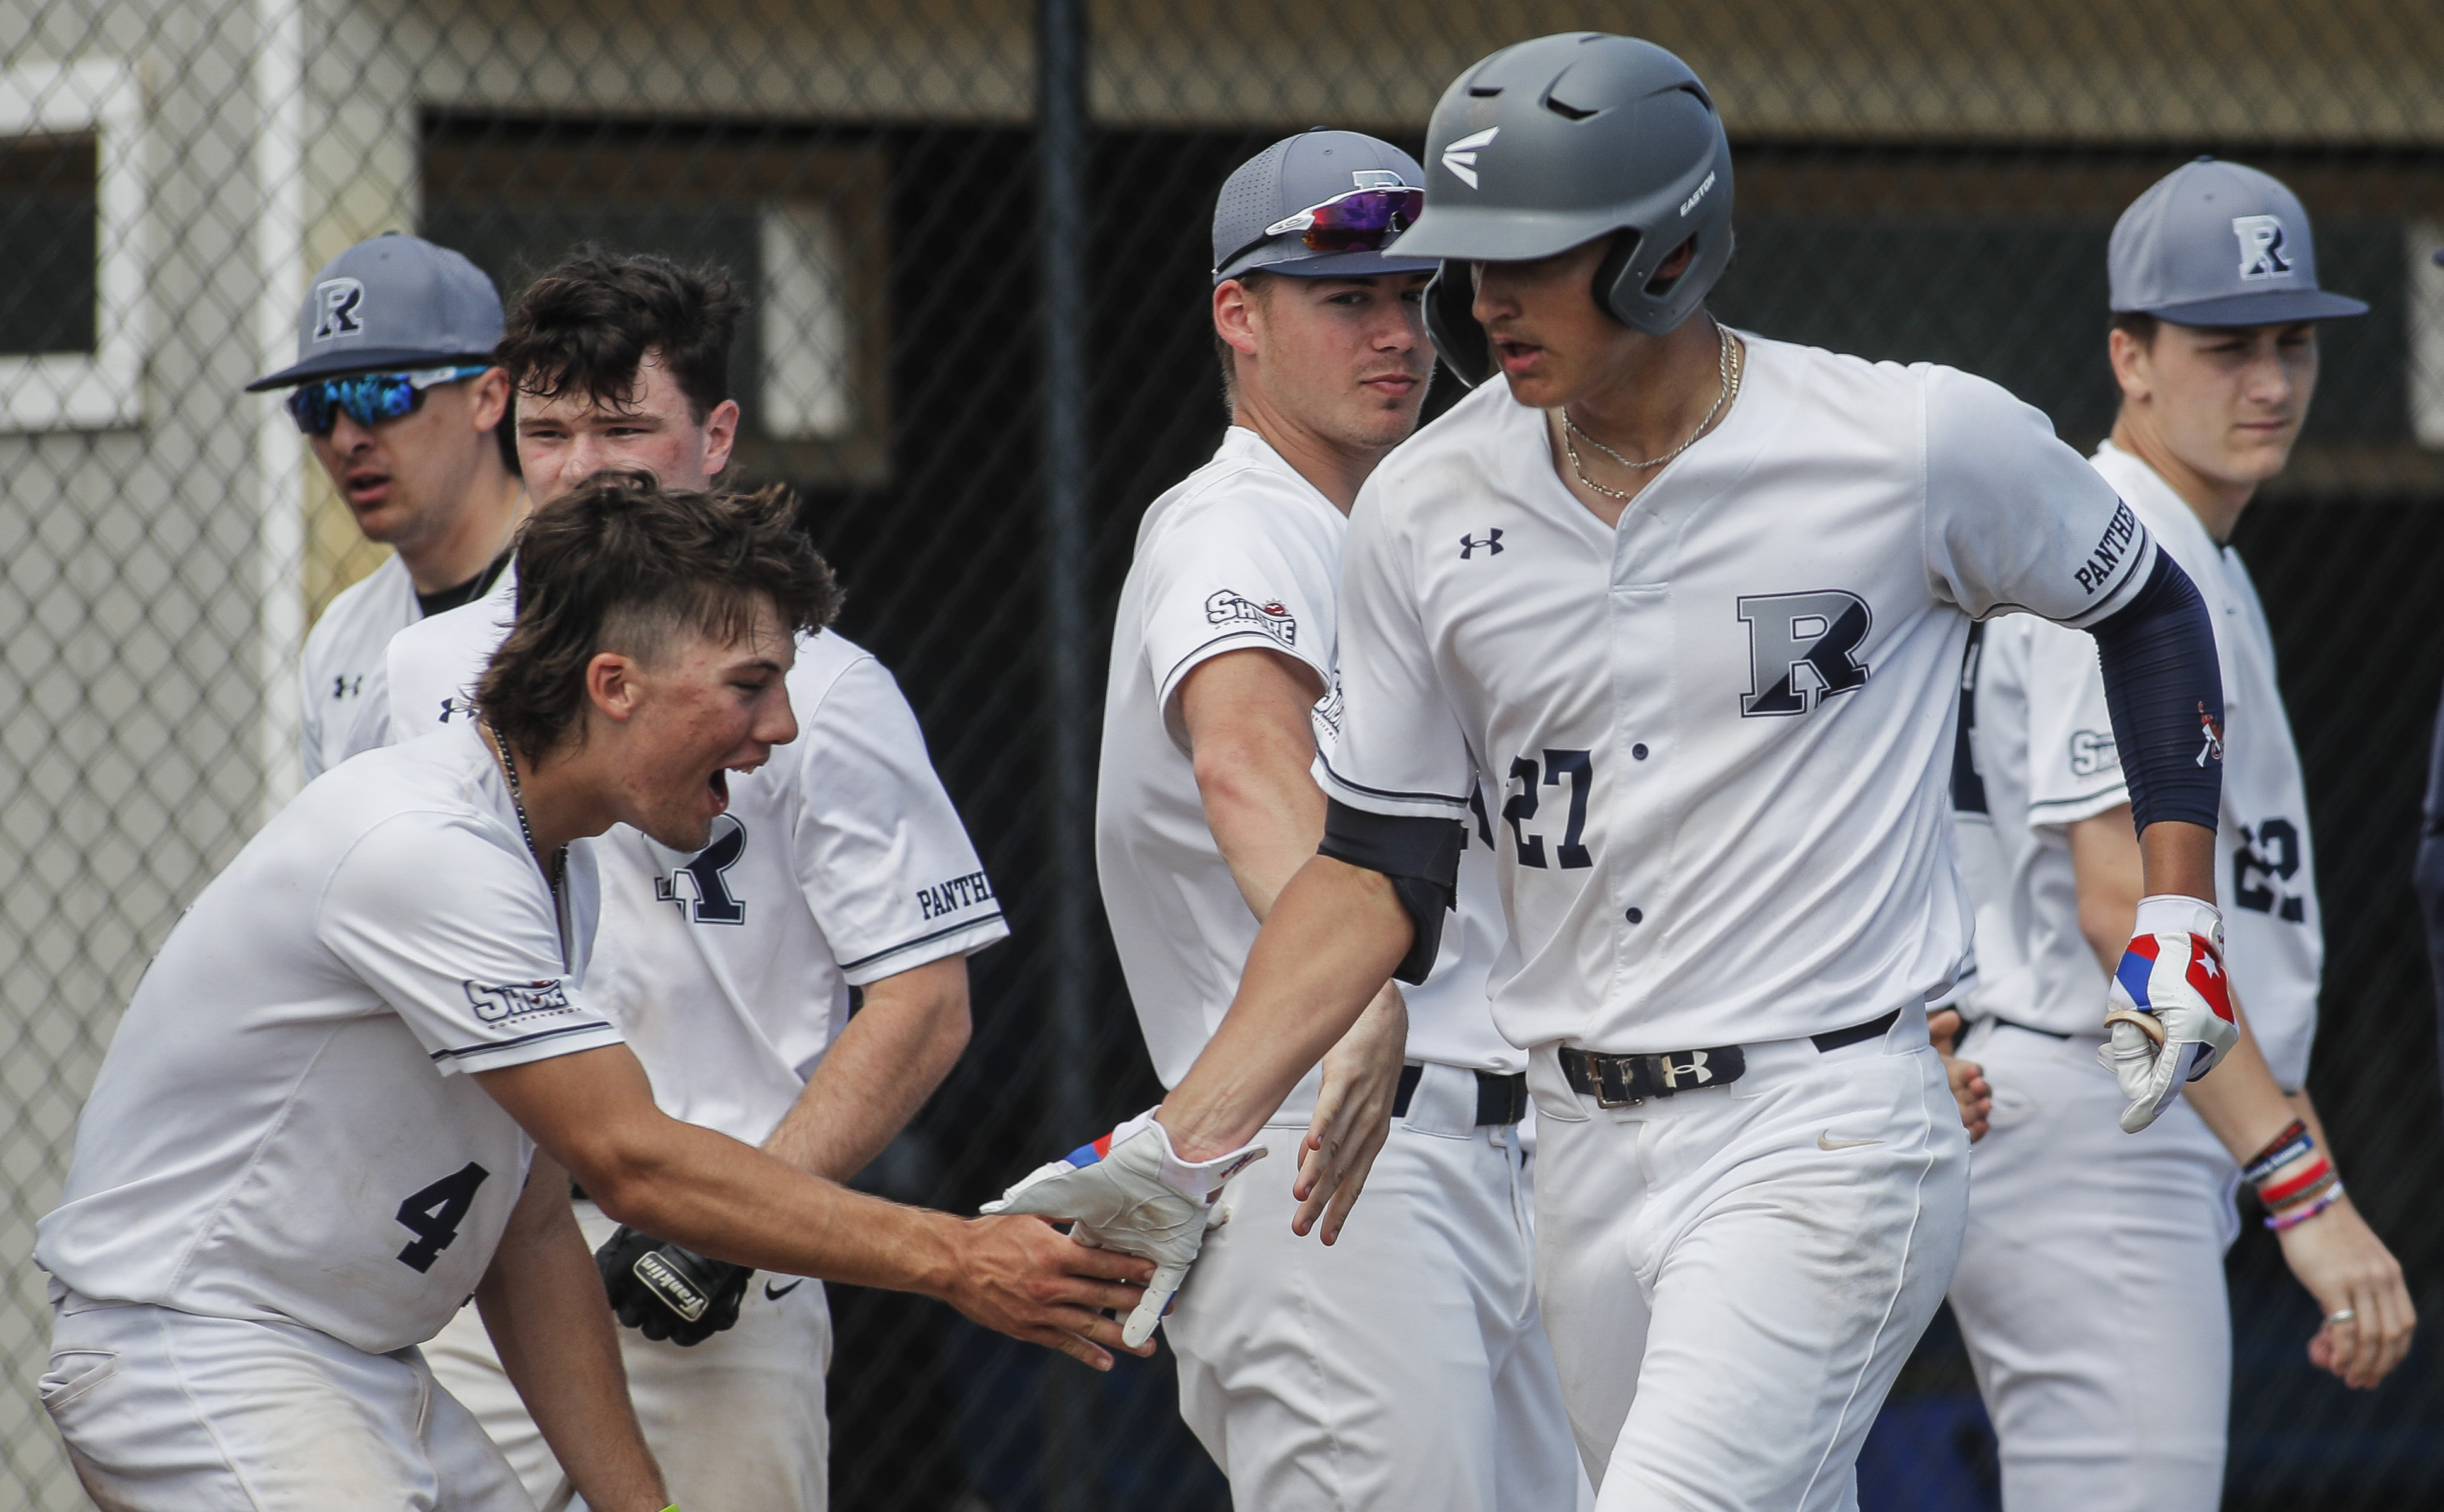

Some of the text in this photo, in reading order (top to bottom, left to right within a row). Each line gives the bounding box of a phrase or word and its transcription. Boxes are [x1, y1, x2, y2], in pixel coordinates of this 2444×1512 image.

[1680, 170, 1715, 217] EASTON
[2232, 214, 2293, 281] R
[313, 276, 365, 343] R
[2073, 502, 2136, 596] PANTHE
[1736, 587, 1872, 718] R
[1502, 747, 1593, 869] 27
[916, 870, 994, 921] PANTH
[395, 1160, 491, 1274] 4
[641, 1257, 705, 1319] Franklin
